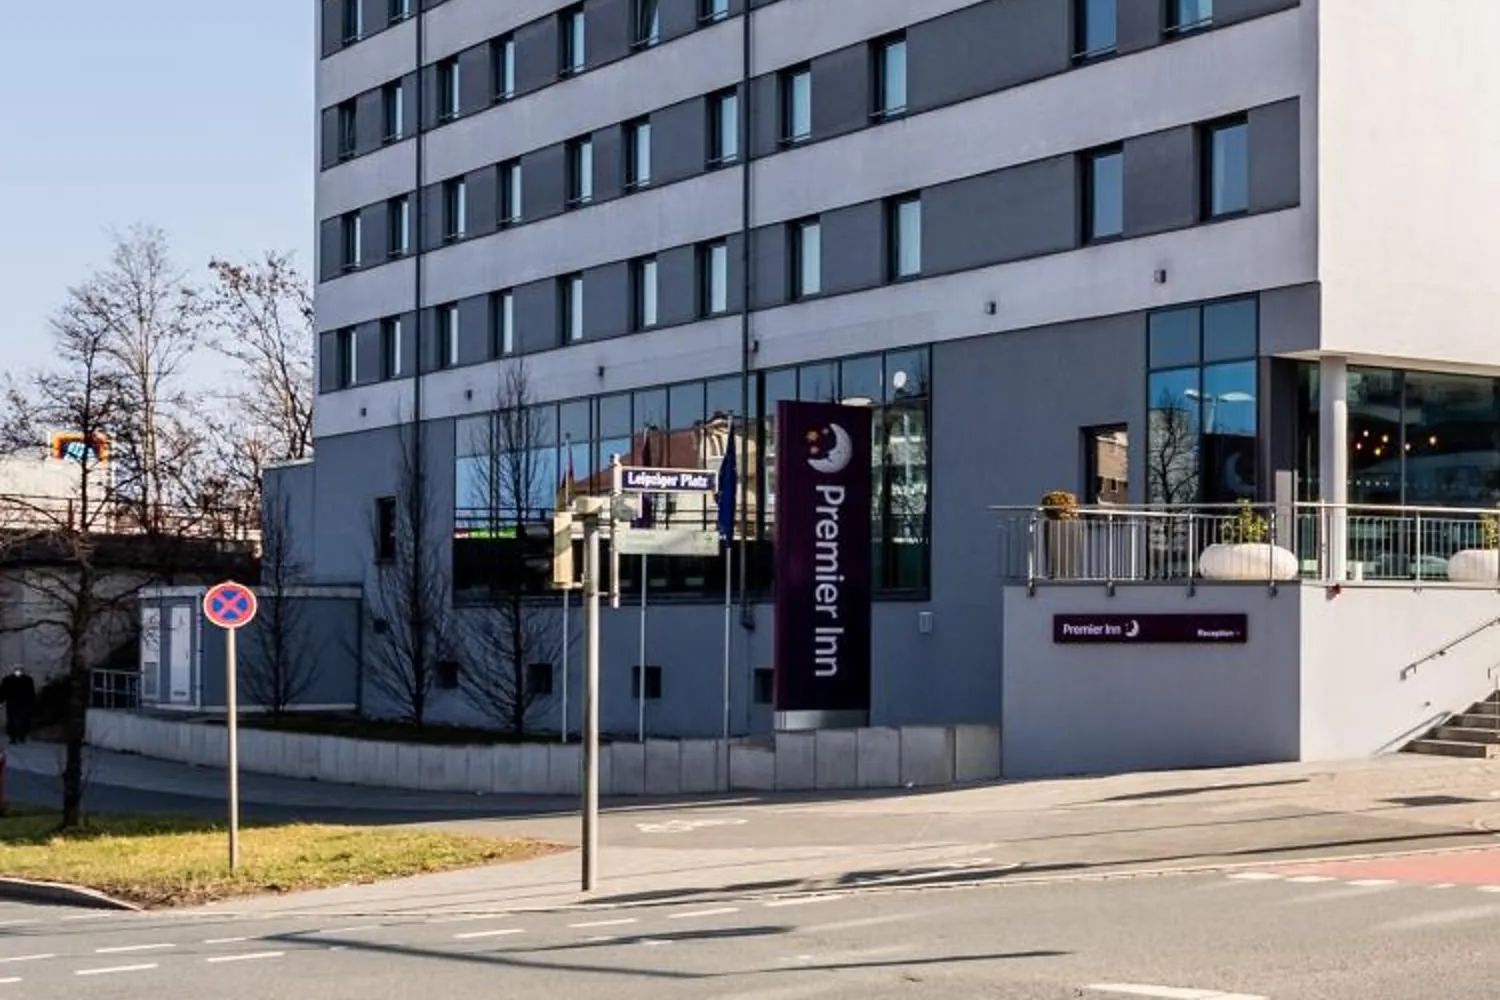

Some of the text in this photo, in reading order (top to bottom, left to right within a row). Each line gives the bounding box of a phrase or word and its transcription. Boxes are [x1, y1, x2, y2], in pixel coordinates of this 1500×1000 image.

[627, 471, 708, 488] Leipziger Platz
[815, 485, 845, 677] Premier Inn
[1063, 623, 1122, 635] Premier Inn
[1197, 629, 1234, 638] Reception
